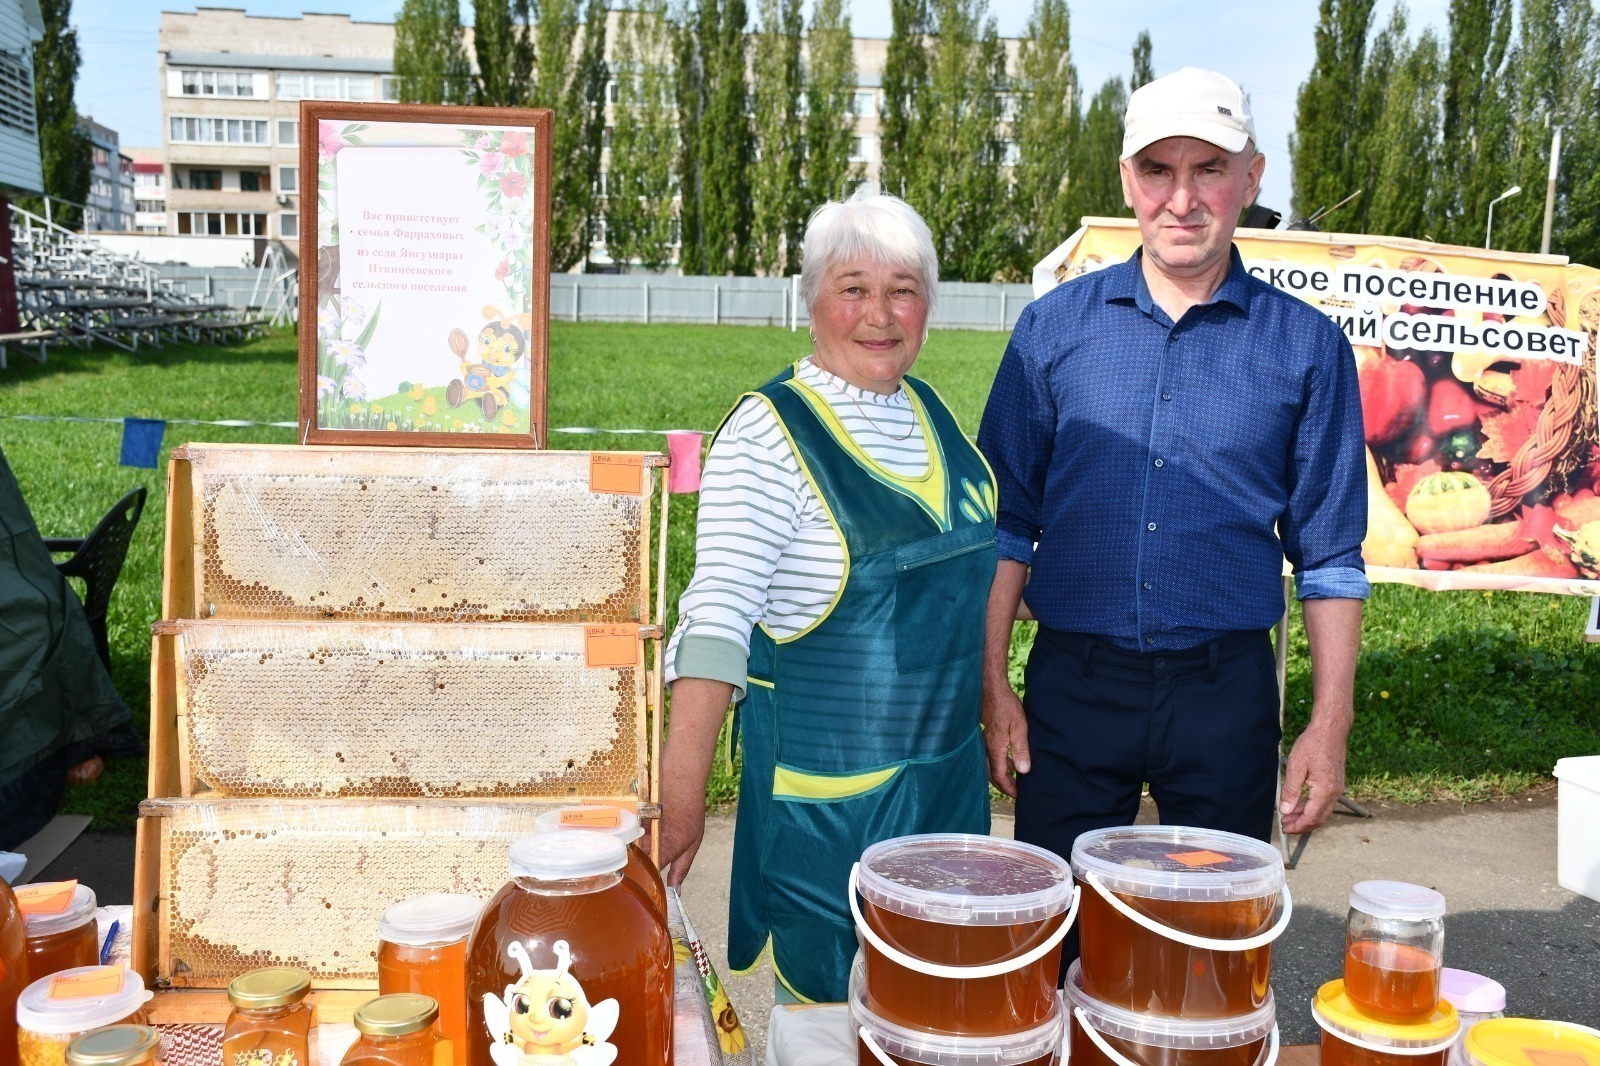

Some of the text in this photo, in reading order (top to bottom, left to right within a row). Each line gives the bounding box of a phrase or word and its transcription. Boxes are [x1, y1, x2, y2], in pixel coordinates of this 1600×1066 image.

[362, 210, 460, 225] Вас приветствует
[357, 228, 464, 240] семья Фарраховых
[357, 248, 369, 256] из
[372, 249, 396, 258] села
[352, 281, 467, 292] сельского поселения
[1342, 273, 1539, 310] поселение
[1328, 310, 1581, 358] ий сельсовет
